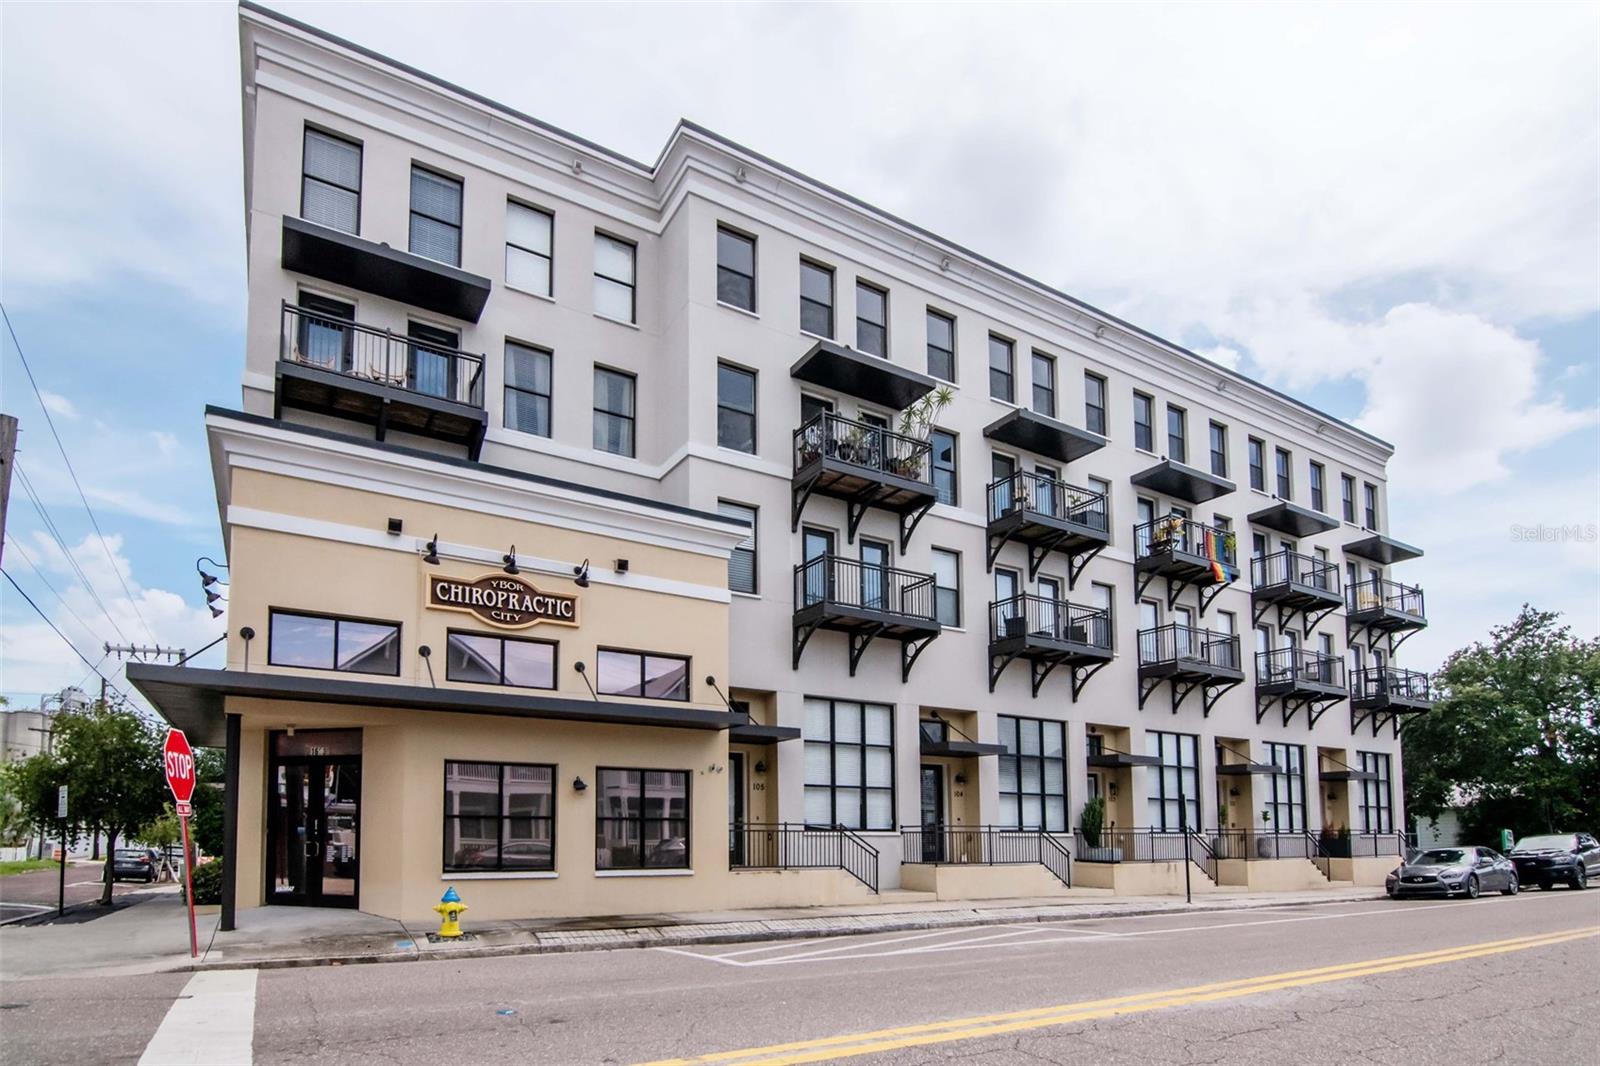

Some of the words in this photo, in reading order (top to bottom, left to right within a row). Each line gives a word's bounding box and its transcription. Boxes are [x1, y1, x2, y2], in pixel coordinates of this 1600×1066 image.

[491, 580, 524, 592] YBOR
[436, 582, 573, 617] CHIROPRACTIC
[491, 611, 522, 622] CITY
[167, 751, 192, 780] STOP
